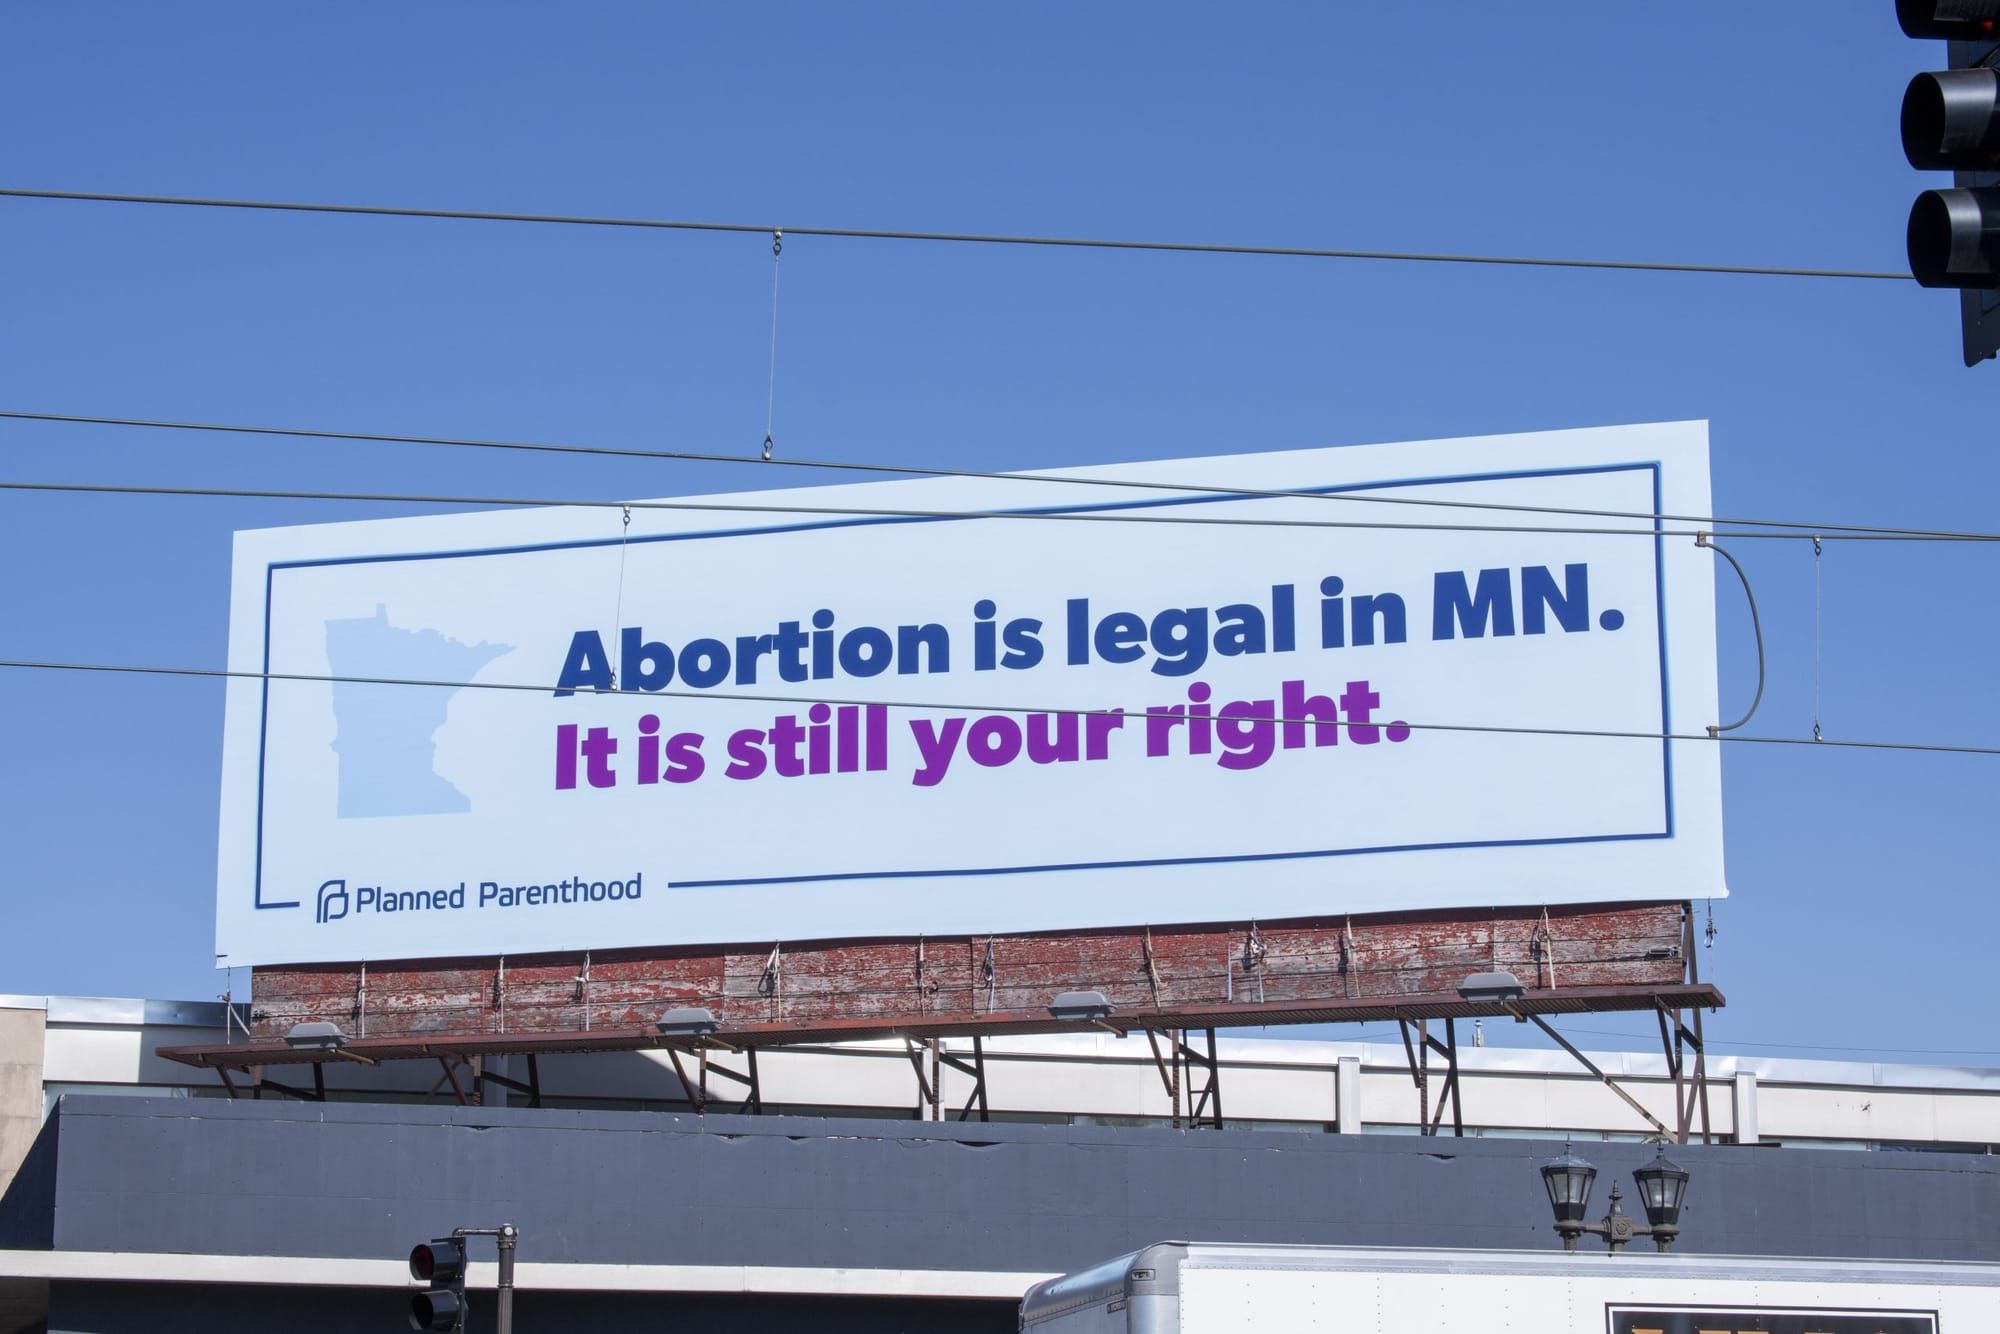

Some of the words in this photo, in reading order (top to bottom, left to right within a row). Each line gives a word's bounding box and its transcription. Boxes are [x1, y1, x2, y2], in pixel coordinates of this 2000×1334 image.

[553, 609, 950, 697] Abortion
[974, 599, 1044, 671] is
[1067, 584, 1296, 677] legal
[1320, 576, 1407, 649] in
[1432, 563, 1625, 640] MN.
[555, 723, 618, 790] It
[637, 714, 705, 785] is
[724, 703, 888, 781] still
[909, 706, 1124, 787] your
[1146, 680, 1411, 770] right.
[356, 882, 466, 914] Planned
[479, 872, 642, 908] Parenthood
